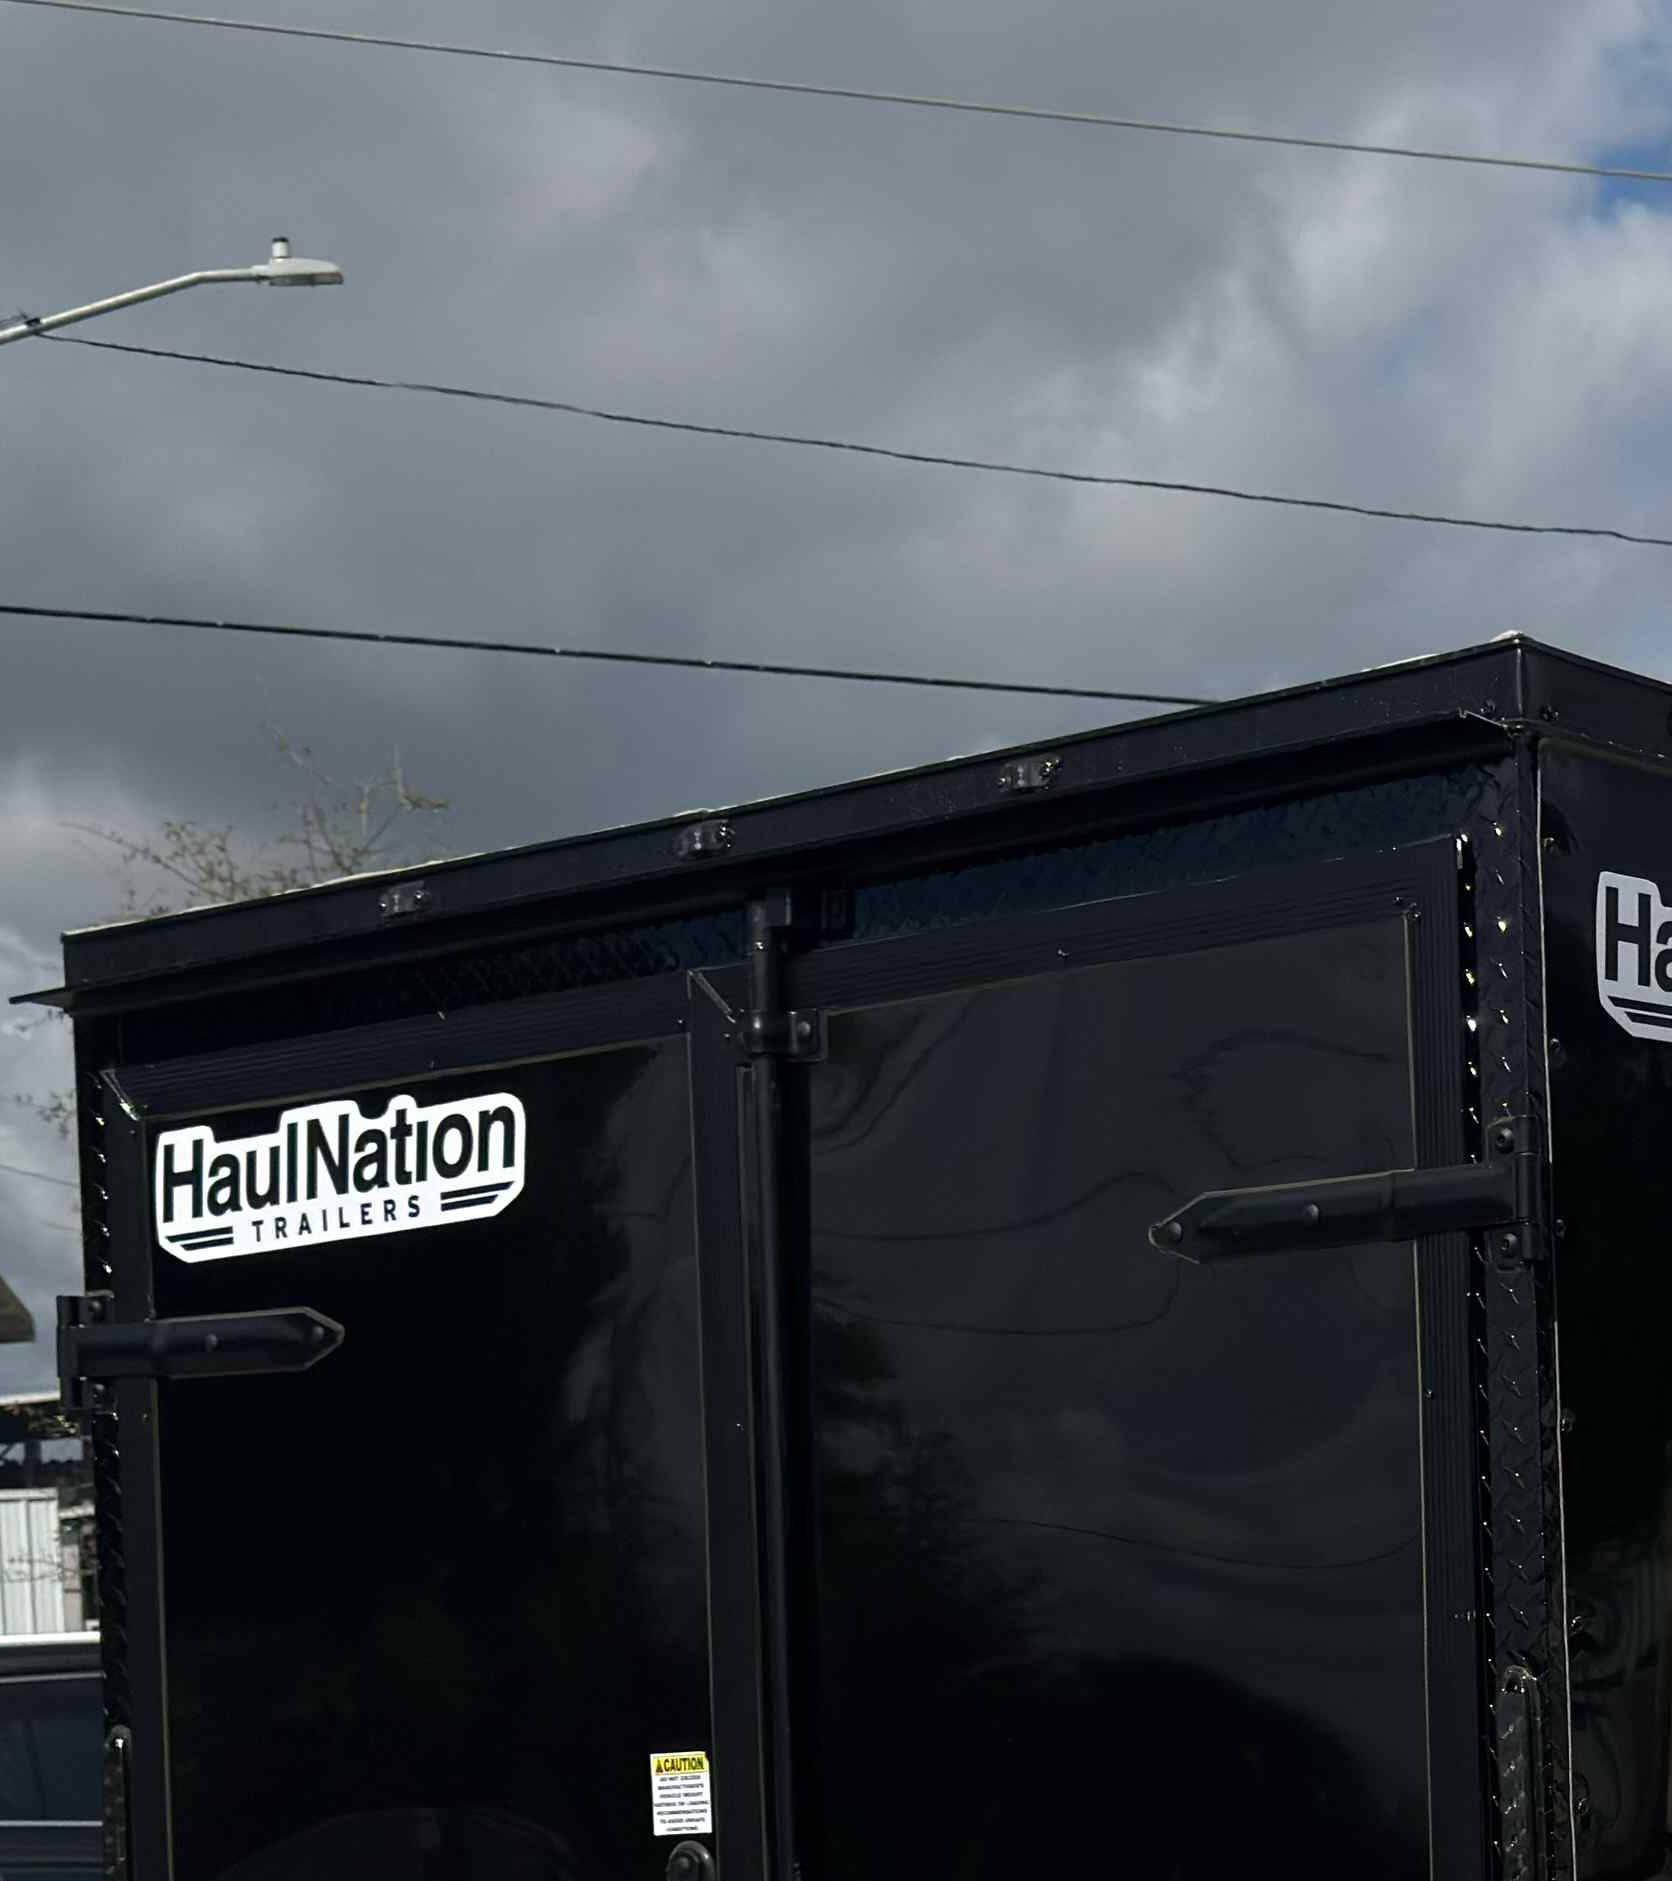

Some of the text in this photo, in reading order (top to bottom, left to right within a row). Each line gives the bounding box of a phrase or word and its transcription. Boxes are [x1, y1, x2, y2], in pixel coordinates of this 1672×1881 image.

[163, 1104, 516, 1224] HaulNation
[251, 1194, 421, 1243] TRAILERS
[664, 1757, 705, 1772] CAUTION
